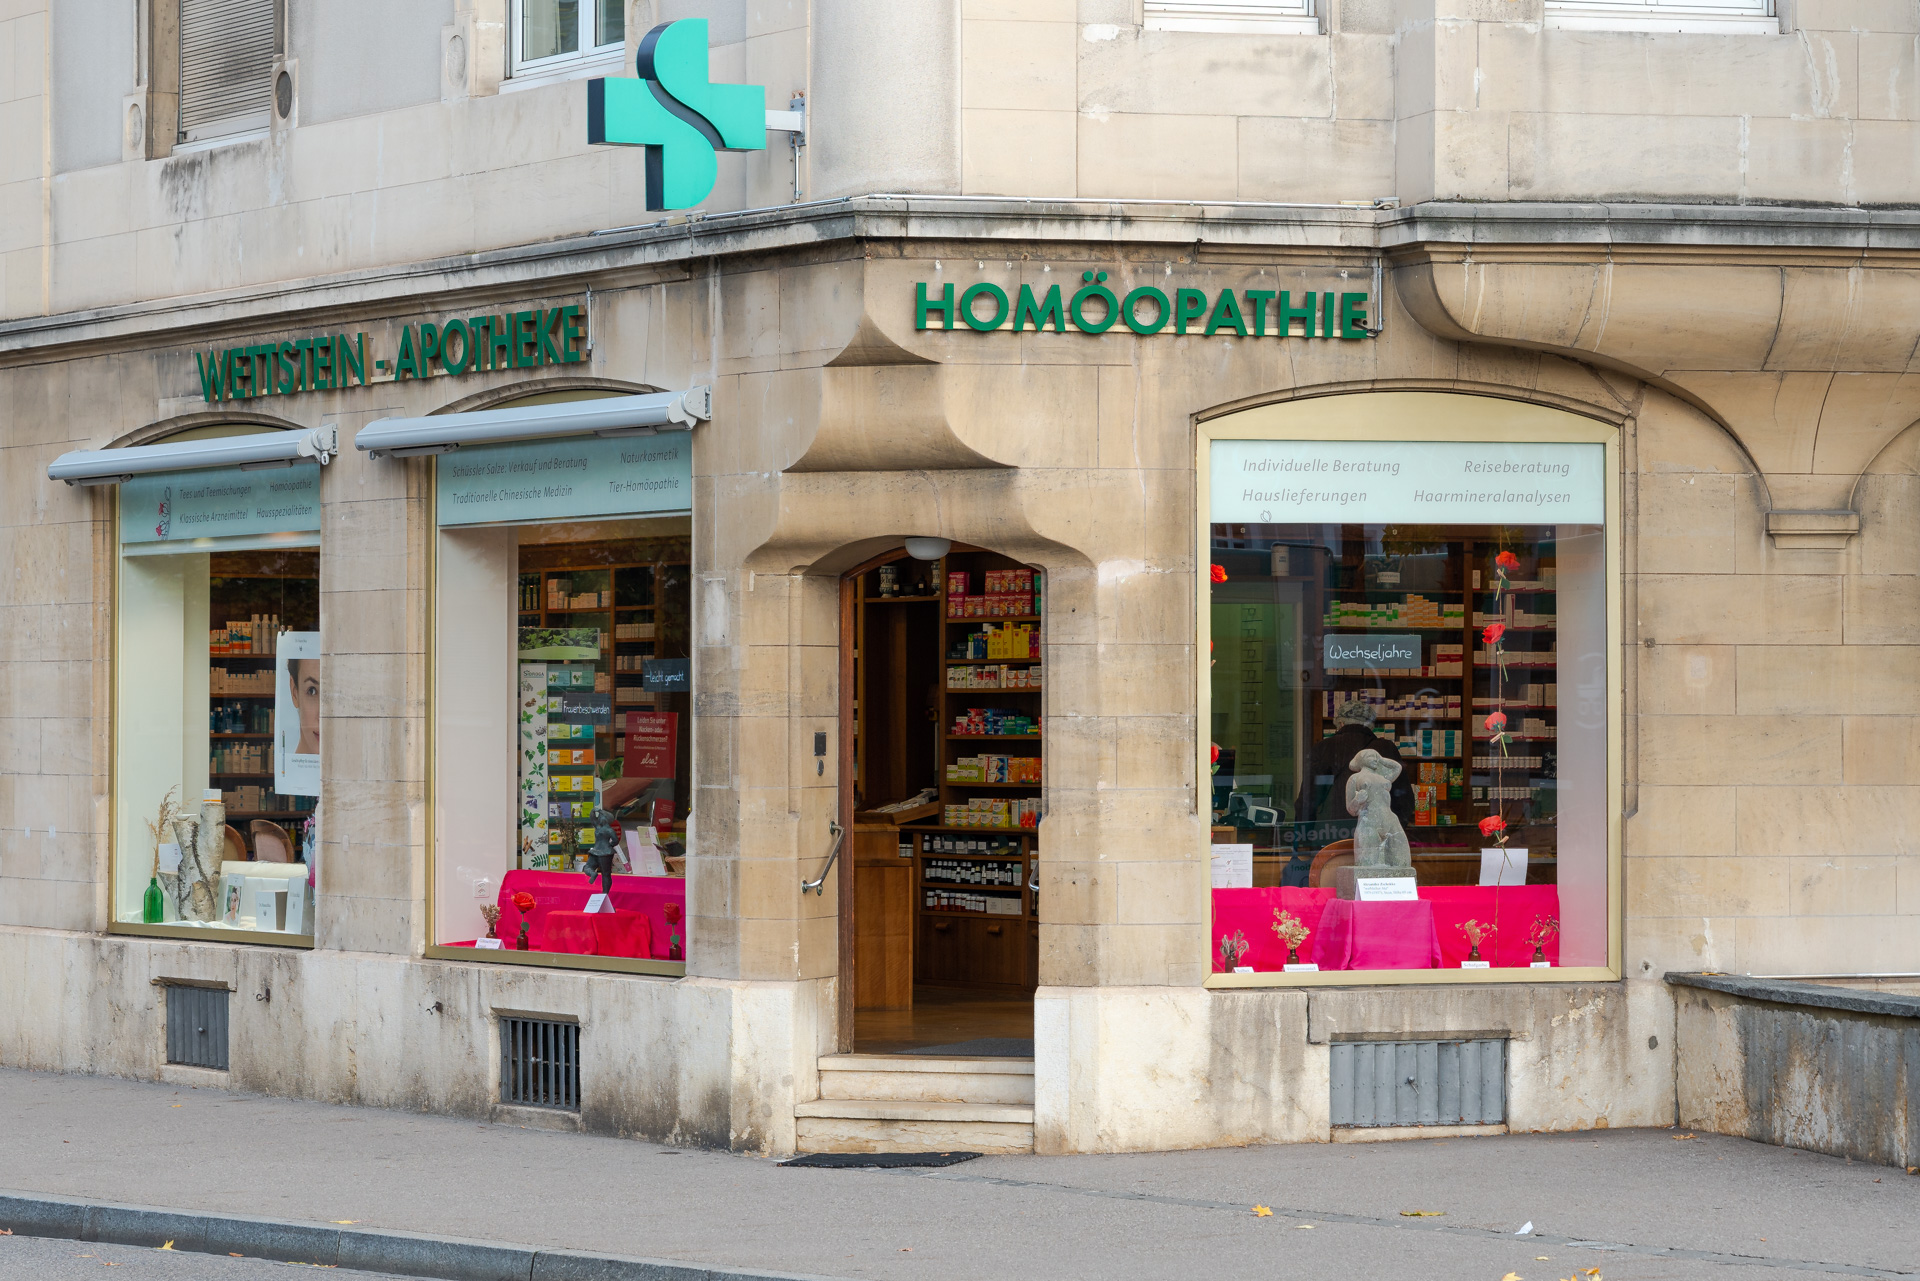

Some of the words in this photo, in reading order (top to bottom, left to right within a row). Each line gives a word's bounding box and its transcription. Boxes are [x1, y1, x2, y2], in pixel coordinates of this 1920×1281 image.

[915, 270, 1369, 340] HOMÖOPATHIE
[196, 332, 370, 403] WETTSTEIN
[394, 304, 585, 381] APOTHEKE
[620, 448, 679, 465] Naturkosmetik
[452, 464, 485, 478] Schüssler
[486, 462, 507, 476] Salze:
[508, 459, 538, 475] Verkauf
[538, 457, 552, 470] und
[553, 456, 588, 471] Beratung
[1242, 458, 1329, 473] Individuelle
[1332, 459, 1401, 476] Beratung
[1463, 460, 1571, 478] Reiseberatung
[179, 488, 193, 500] Tees
[193, 486, 206, 499] und
[205, 484, 252, 499] Teemischungen
[269, 478, 312, 494] Homöopathie
[452, 488, 498, 505] Traditionelle
[498, 485, 542, 501] Chinesische
[543, 485, 573, 498] Medizin
[608, 477, 679, 495] Tier-Homöopathie
[1242, 488, 1368, 505] Hauslieferungen
[1413, 488, 1572, 506] Haarmineralanalysen
[179, 511, 210, 524] Klassische
[210, 508, 249, 522] Arzneimittel
[256, 504, 313, 521] Hausspezialitäten
[1329, 643, 1413, 662] Wechseljahre
[563, 700, 610, 714] Frauenbeschwerden
